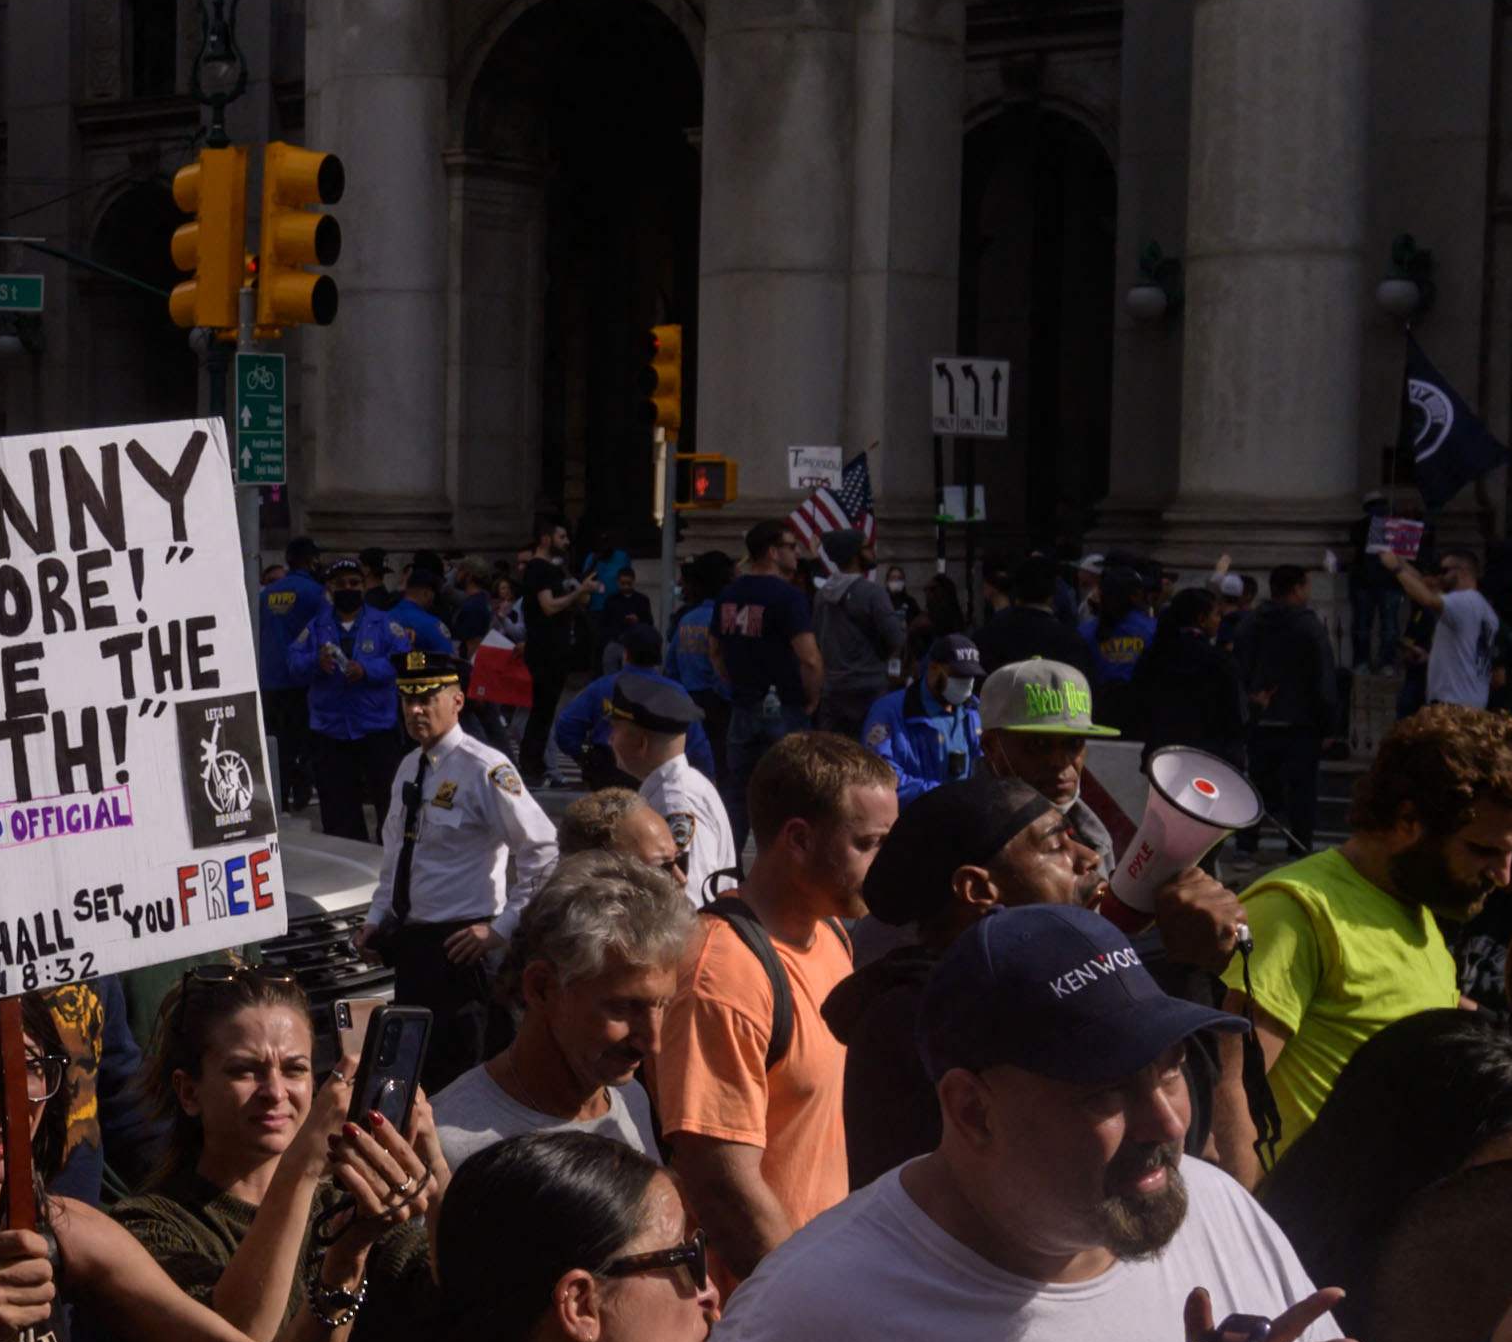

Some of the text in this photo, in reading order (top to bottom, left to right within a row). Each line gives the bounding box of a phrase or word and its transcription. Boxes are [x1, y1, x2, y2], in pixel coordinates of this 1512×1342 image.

[101, 615, 220, 700] THE
[1024, 683, 1063, 718] New
[11, 795, 132, 843] OFFICIAL
[1127, 840, 1154, 879] PYLE
[73, 884, 125, 923] SET
[123, 893, 175, 940] YOU
[22, 953, 99, 990] 8:32
